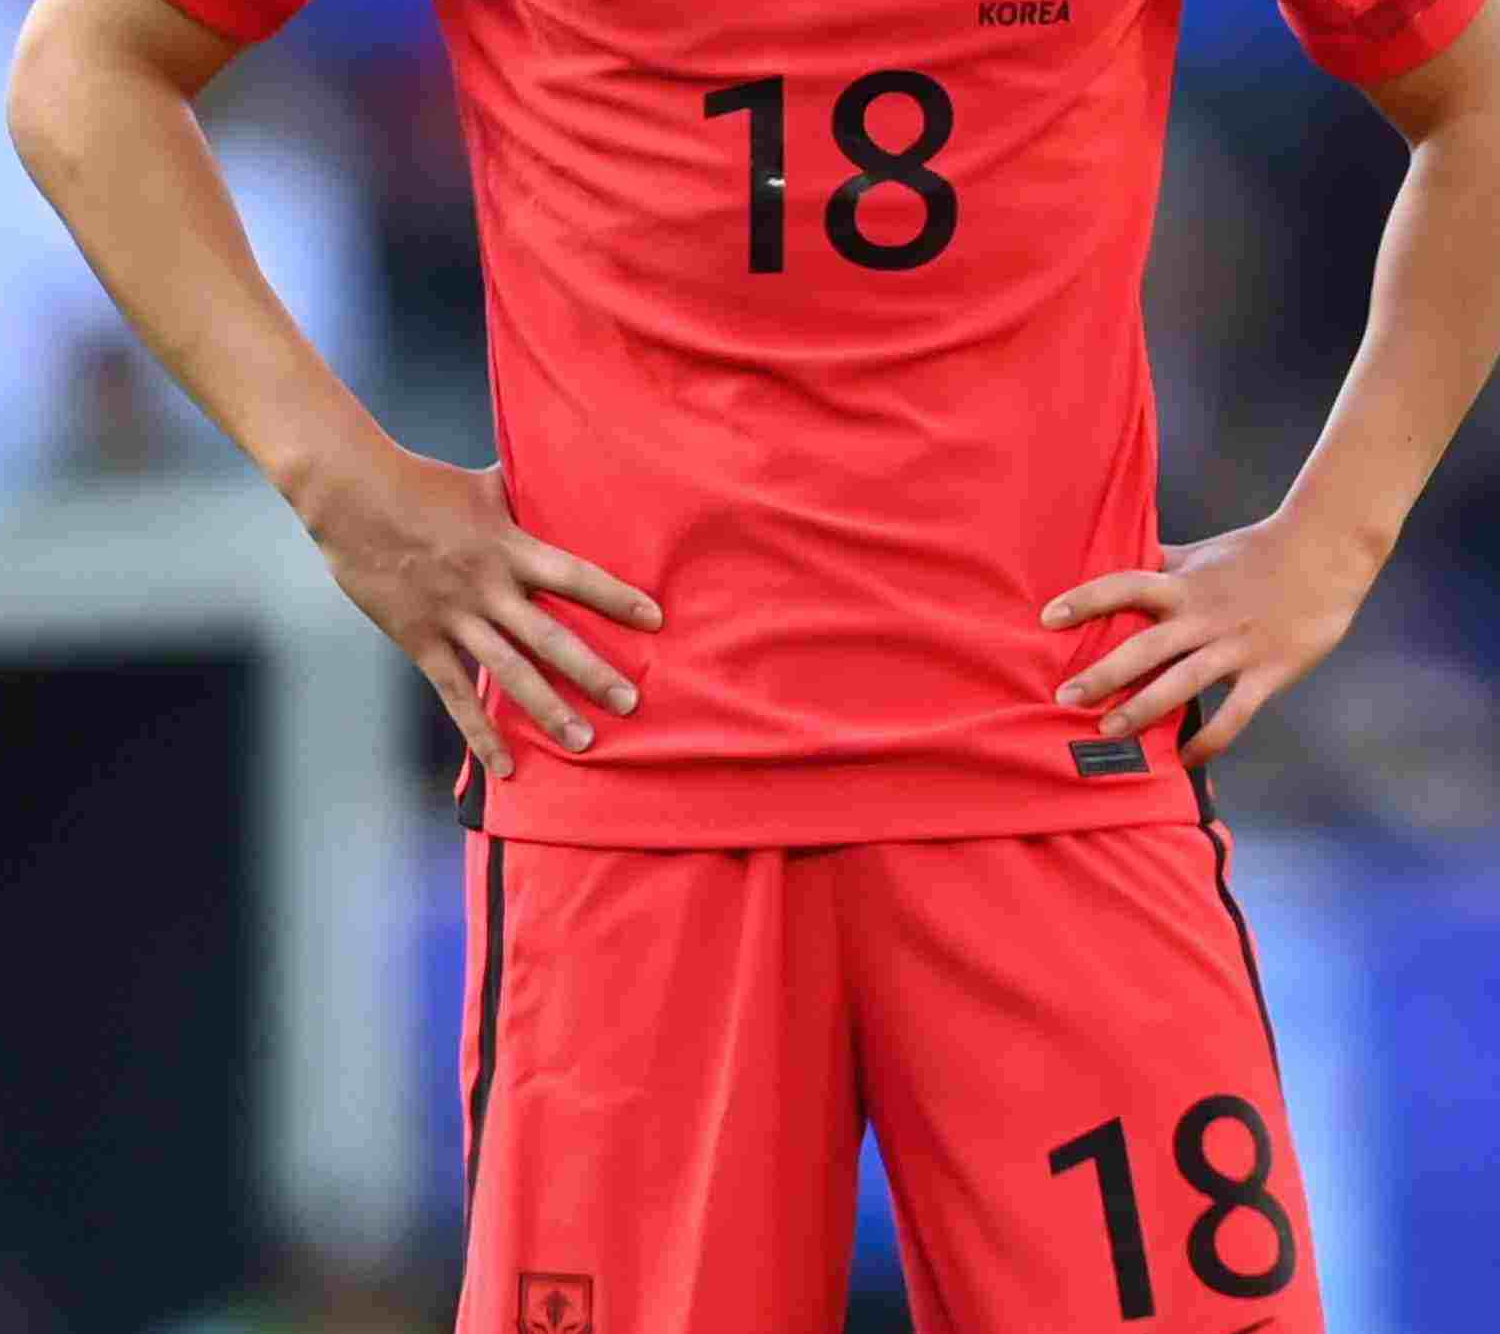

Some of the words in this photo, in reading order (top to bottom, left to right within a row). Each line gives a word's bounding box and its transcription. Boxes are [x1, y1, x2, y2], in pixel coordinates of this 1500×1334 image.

[978, 0, 1071, 26] KOREA
[703, 69, 959, 274] 18
[1048, 1093, 1297, 1323] 18
